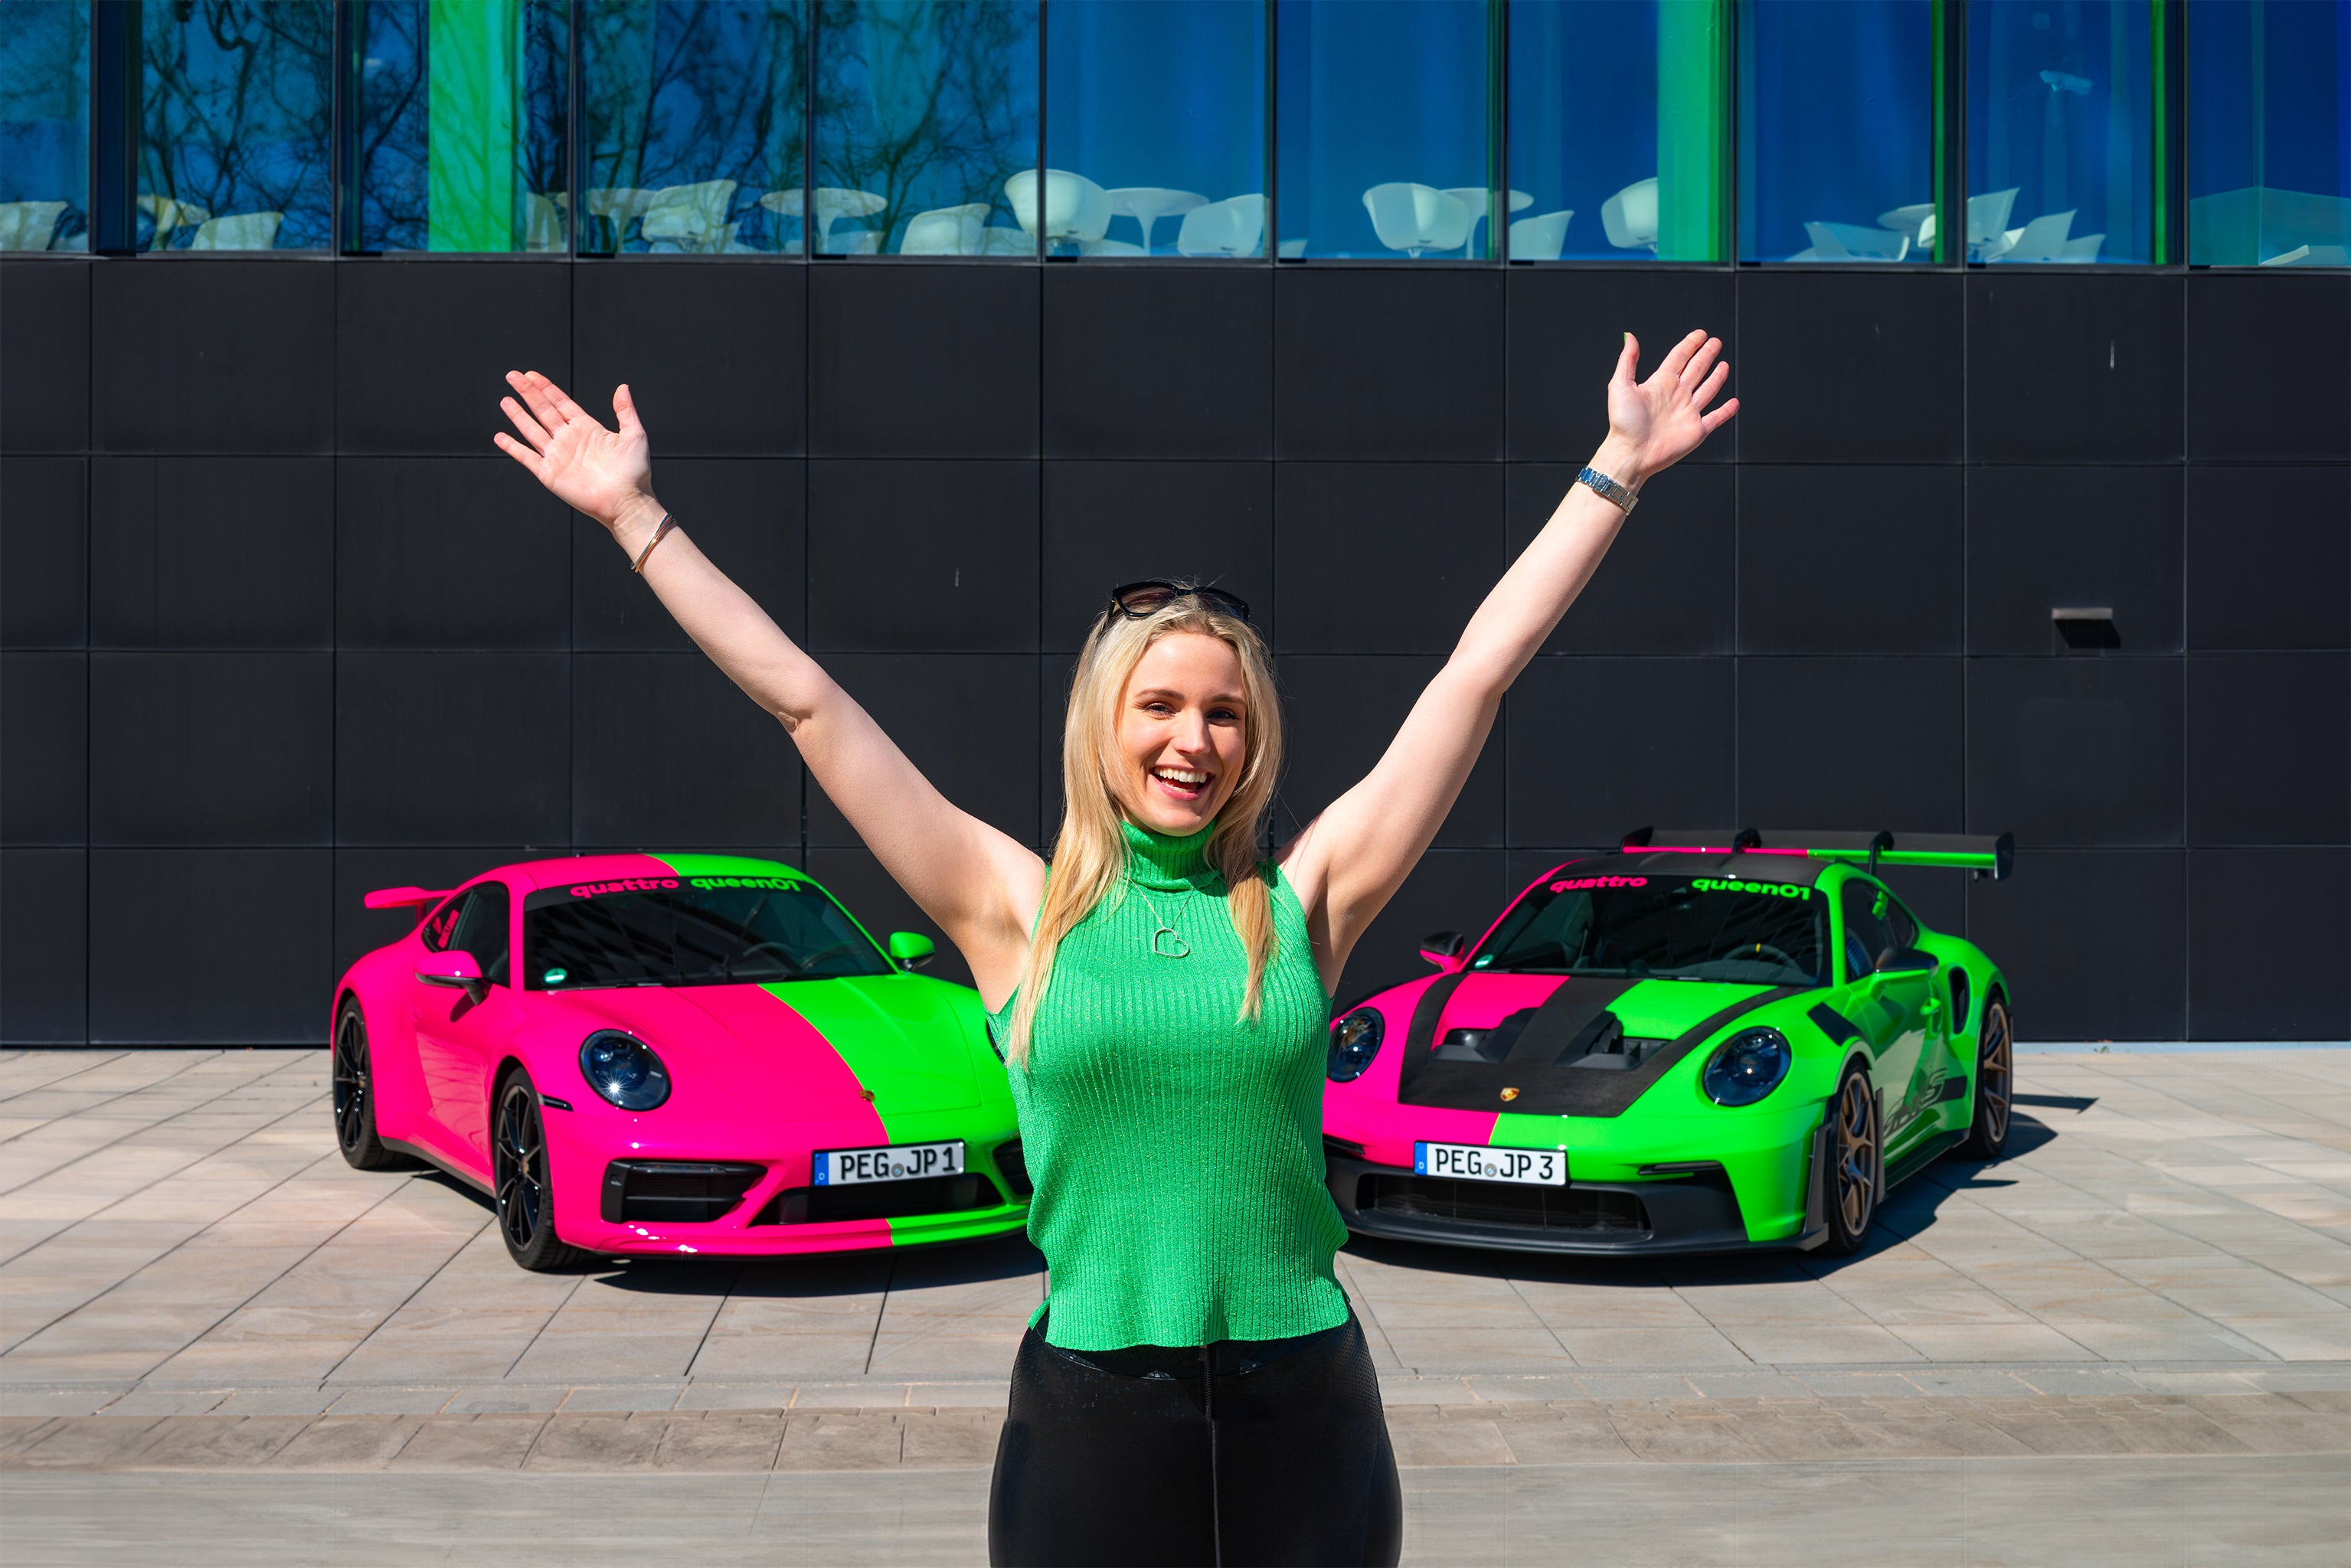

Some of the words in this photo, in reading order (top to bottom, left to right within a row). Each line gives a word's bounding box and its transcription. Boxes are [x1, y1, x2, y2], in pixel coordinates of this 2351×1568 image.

[570, 878, 679, 899] quattro
[690, 877, 801, 892] queen01
[1549, 876, 1647, 893] quattro
[1692, 878, 1810, 901] queen01
[839, 1152, 890, 1181] PEG
[1417, 1161, 1425, 1170] D
[1435, 1148, 1483, 1175] PEG
[1499, 1153, 1532, 1178] JP
[818, 1171, 826, 1181] D
